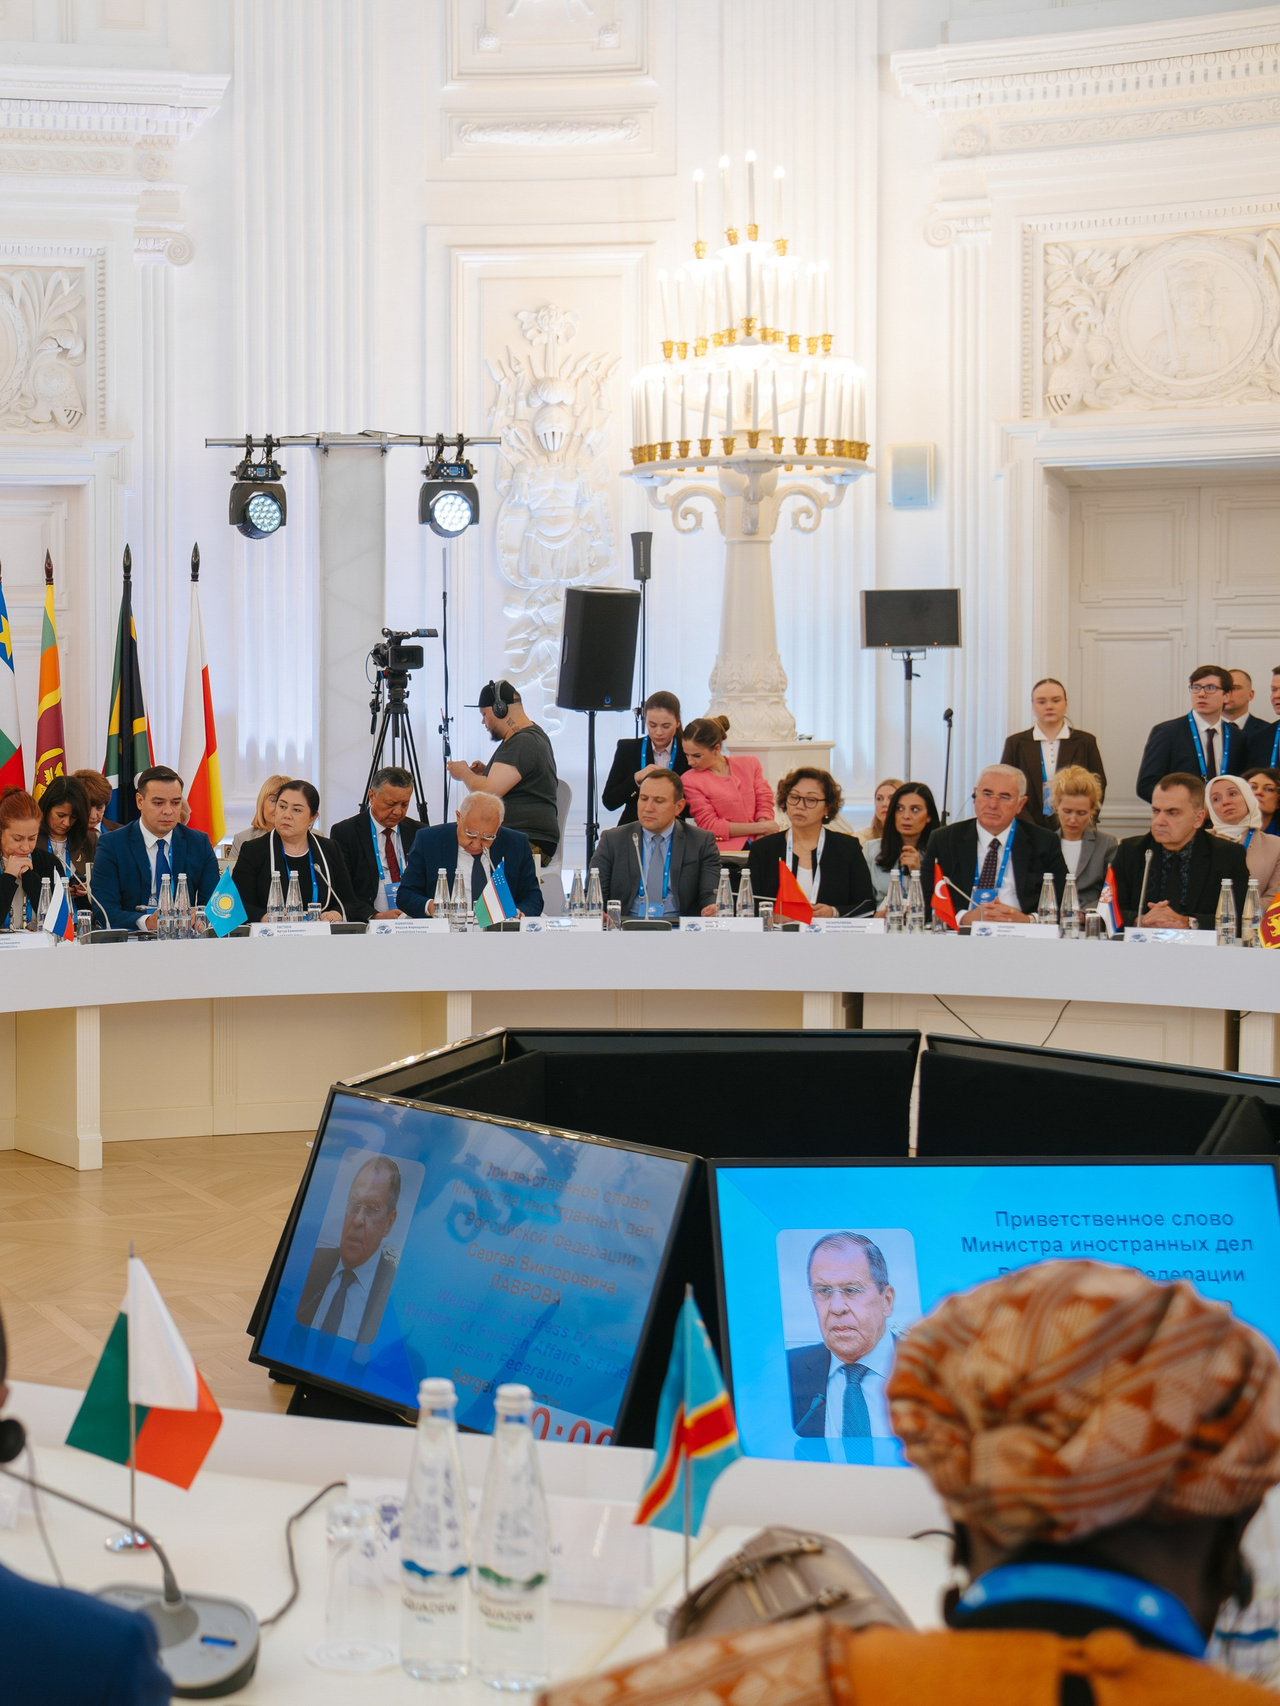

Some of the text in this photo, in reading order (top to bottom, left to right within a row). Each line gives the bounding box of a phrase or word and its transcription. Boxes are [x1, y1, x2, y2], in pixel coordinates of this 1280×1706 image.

[451, 1179, 655, 1241] Министра иностранных дел
[482, 1161, 651, 1212] Приветственное слово
[465, 1211, 637, 1268] Российской Федерации
[961, 1236, 1254, 1255] Министра иностранных дел
[995, 1211, 1235, 1230] Приветственное слово
[467, 1242, 618, 1296] Сергея Викторовича
[488, 1273, 562, 1307] ЛАВРОВА
[403, 1301, 458, 1329] Minister
[460, 1316, 477, 1333] of
[477, 1320, 530, 1353] Foreign
[534, 1338, 581, 1366] Affairs
[436, 1288, 511, 1323] Welcoming
[513, 1308, 569, 1338] address
[440, 1335, 576, 1387] Russian Federation
[450, 1367, 497, 1395] Sergei
